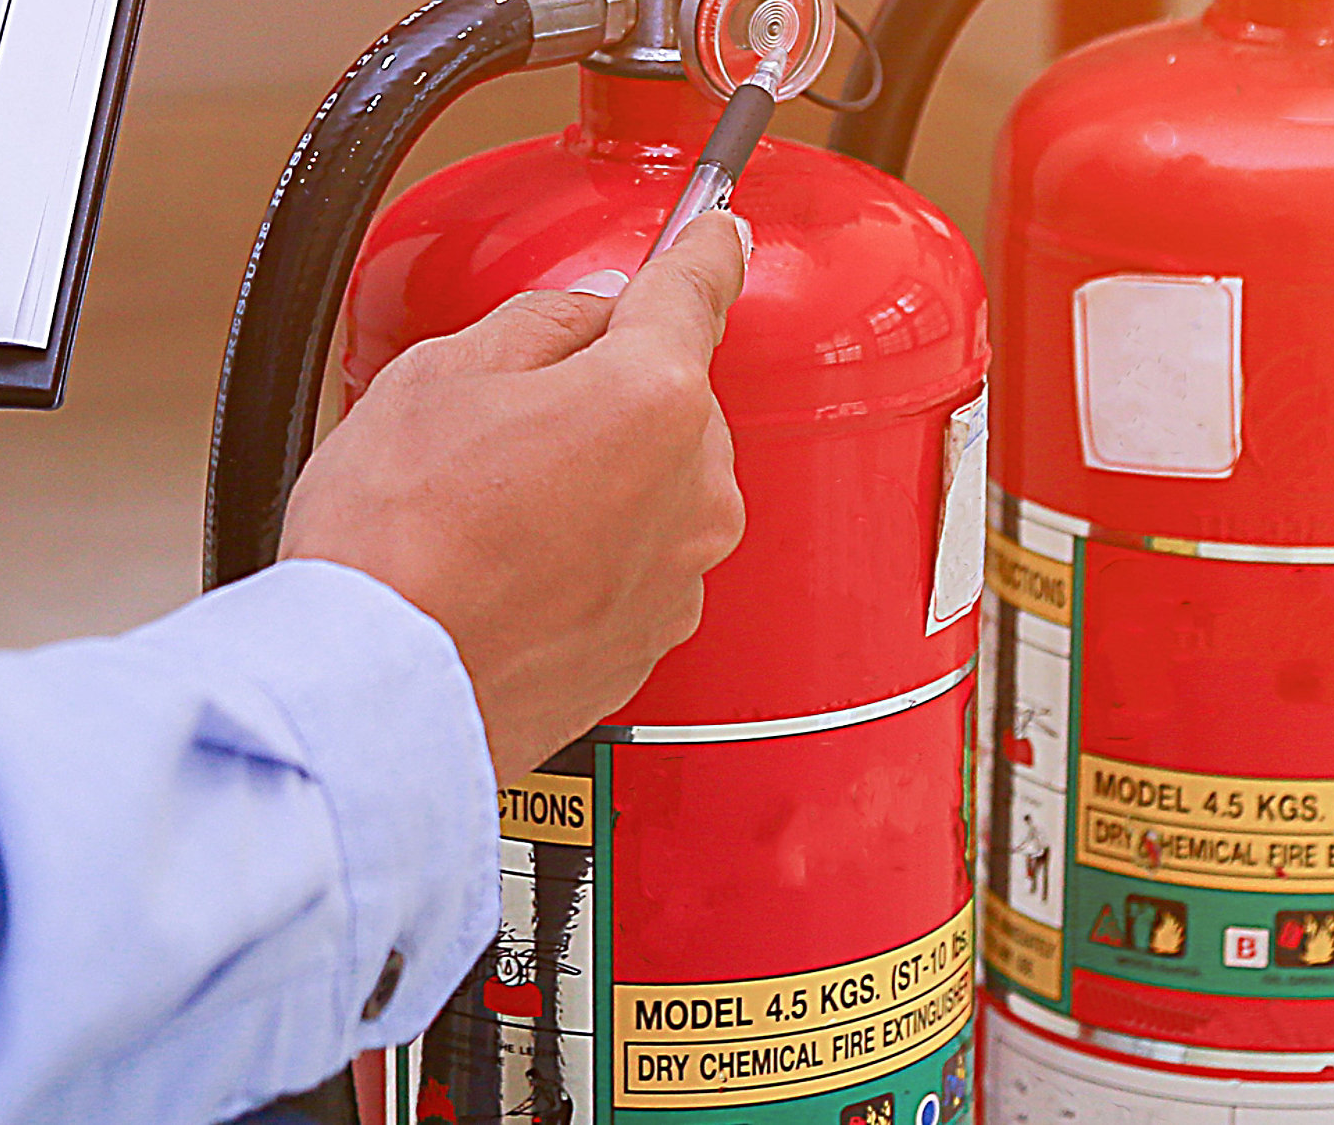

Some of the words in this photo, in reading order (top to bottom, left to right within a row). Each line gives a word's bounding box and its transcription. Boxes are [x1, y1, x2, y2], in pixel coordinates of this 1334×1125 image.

[498, 789, 584, 828] CTIONS
[1094, 770, 1190, 813] MODEL
[1203, 790, 1243, 819] 4.5
[1257, 792, 1326, 823] KGS.
[1137, 830, 1259, 866] CHEMICAL
[1268, 843, 1316, 868] FIRE
[1236, 936, 1257, 960] B
[634, 997, 753, 1031] MODEL
[766, 987, 808, 1022] 4.5
[819, 974, 881, 1015] KGS.
[891, 941, 946, 1000] (ST-10
[638, 1053, 689, 1082] DRY
[699, 1040, 823, 1081] CHEMICAL
[831, 1025, 876, 1061] FIRE
